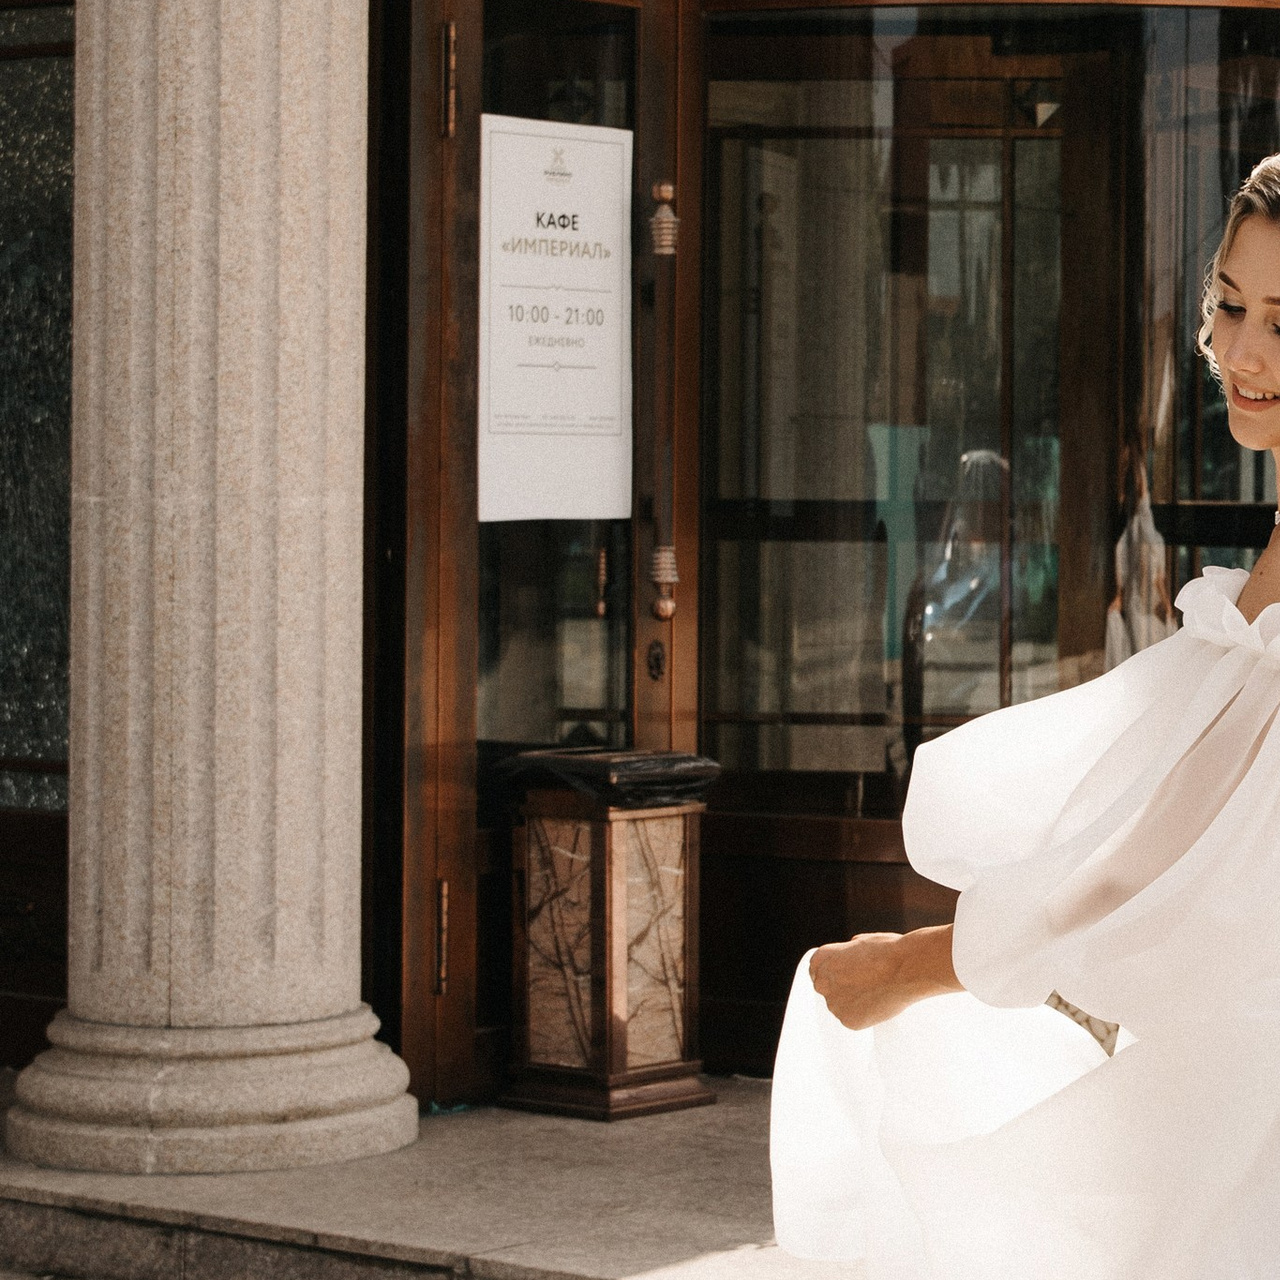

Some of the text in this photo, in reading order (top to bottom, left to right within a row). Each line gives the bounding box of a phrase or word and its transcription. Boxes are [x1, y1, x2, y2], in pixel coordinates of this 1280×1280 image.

[535, 211, 579, 231] КАФЕ
[502, 237, 611, 259] «ИМПЕРИАЛ»
[508, 304, 549, 323] 10:00
[565, 306, 605, 326] 21:00
